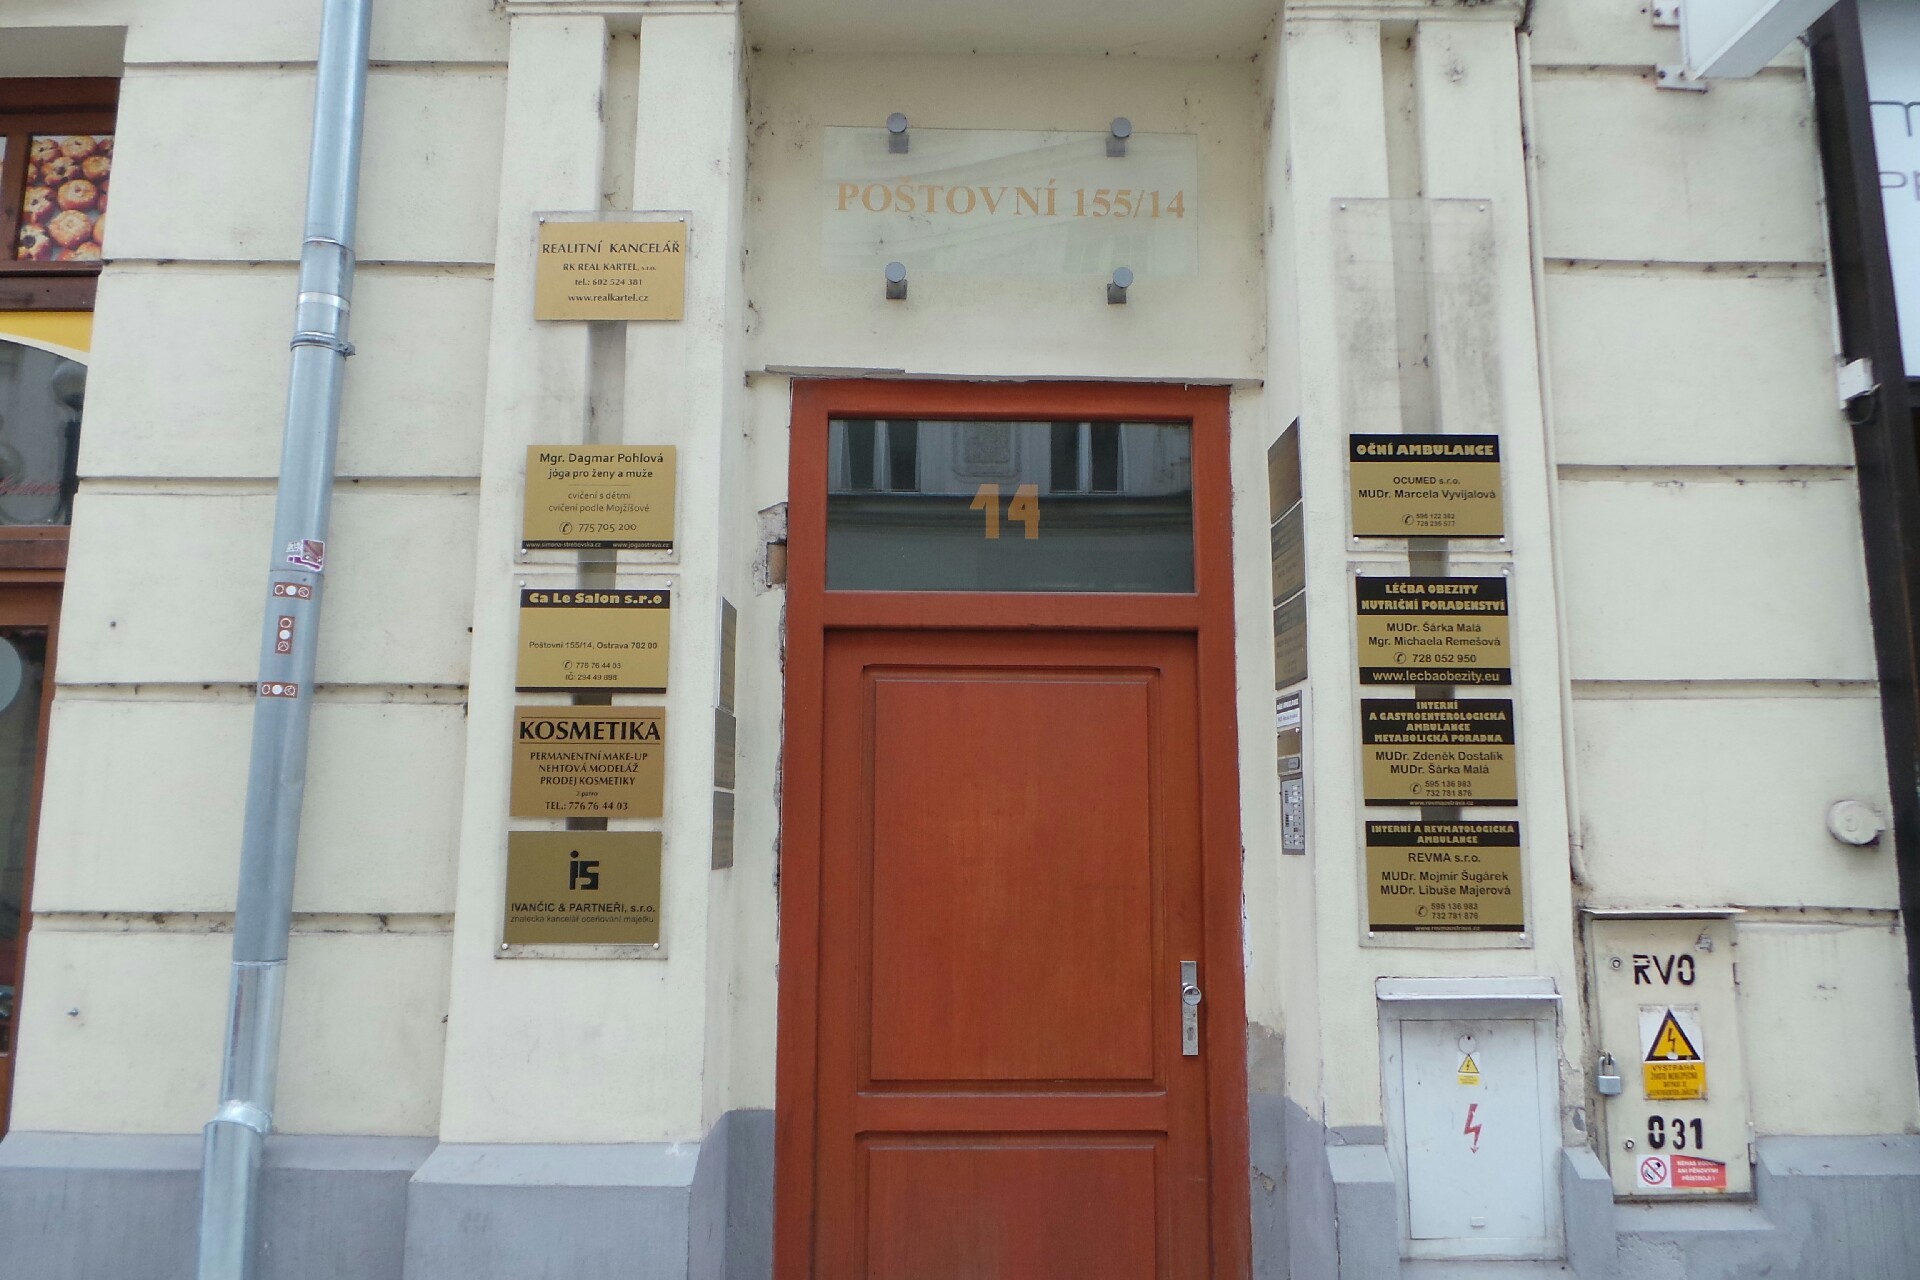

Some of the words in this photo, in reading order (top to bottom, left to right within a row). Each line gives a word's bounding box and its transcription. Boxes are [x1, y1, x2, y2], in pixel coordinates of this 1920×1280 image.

[835, 177, 1057, 216] POŠTOVNÍ
[1073, 187, 1186, 219] 155/14
[542, 240, 603, 254] REALITNÍ
[609, 240, 680, 253] KANCELÁŘ
[563, 263, 576, 271] RK
[578, 263, 600, 271] REAL
[603, 263, 640, 272] KARTEL,
[568, 293, 649, 302] www.realkartel.cz
[1356, 442, 1394, 456] OČNÍ
[1396, 444, 1494, 456] AMBULANCE
[539, 453, 565, 466] Mgr.
[568, 453, 614, 466] Dagmar
[617, 452, 664, 464] Pohlová
[547, 468, 571, 480] jóga
[572, 470, 589, 480] pro
[591, 468, 615, 480] ženy
[617, 470, 624, 478] a
[626, 468, 653, 478] muže
[1393, 476, 1437, 485] OCUMED
[567, 491, 598, 500] cvičení
[605, 491, 631, 500] dětmi
[1358, 489, 1392, 499] MUDr.
[1394, 489, 1439, 499] Marcela
[548, 503, 578, 512] cvičení
[579, 503, 604, 514] podle
[606, 503, 650, 514] Mojžíšové
[969, 483, 1041, 540] 14
[578, 523, 595, 533] 775
[597, 523, 615, 533] 705
[618, 523, 637, 531] 200
[1385, 583, 1426, 594] LÉČBA
[1427, 584, 1479, 594] OBEZITY
[529, 592, 549, 604] Ca
[552, 592, 571, 604] Le
[574, 593, 620, 604] Salon
[624, 594, 662, 605] s.r.o
[1361, 598, 1419, 610] NUTRIČNÍ
[1421, 599, 1506, 611] PORADENSTVÍ
[1386, 622, 1420, 632] MUDr.
[1422, 620, 1454, 632] Šárka
[1456, 622, 1482, 632] Malá
[529, 641, 564, 649] Poštovní
[565, 641, 595, 650] 155/14,
[596, 641, 629, 650] Ostrava
[630, 642, 646, 650] 702
[647, 642, 658, 650] 00
[1368, 636, 1391, 648] Mgr.
[1394, 636, 1443, 646] Michaela
[1445, 636, 1501, 646] Remešová
[1412, 654, 1431, 663] 728
[1434, 654, 1454, 663] 052
[1457, 654, 1477, 663] 950
[1372, 670, 1500, 683] www.lecbaobezity.eu
[1416, 700, 1458, 710] INTERNÍ
[1369, 712, 1378, 721] A
[1379, 711, 1507, 721] GASTROENTEROLOGICKÁ
[519, 721, 661, 741] KOSMETIKA
[1406, 723, 1471, 732] AMBULANCE
[1374, 733, 1449, 743] METABOLICKÁ
[1451, 734, 1503, 743] PORADNA
[530, 751, 602, 761] PERMANENTNÍ
[602, 752, 648, 761] MAKE-UP
[1375, 751, 1410, 761] MUDr.
[1412, 751, 1455, 761] Zdeněk
[538, 763, 587, 773] NEHTOVÁ
[589, 762, 639, 773] MODELÁŽ
[1390, 765, 1425, 774] MUDr.
[1428, 763, 1461, 775] Šárka
[1463, 765, 1490, 775] Malá
[540, 776, 577, 786] PRODEJ
[579, 776, 636, 786] KOSMETIKY
[1424, 780, 1440, 788] 595
[1457, 780, 1472, 788] 983
[1425, 789, 1440, 797] 732
[568, 801, 586, 811] 776
[587, 801, 599, 811] 76
[602, 801, 614, 811] 44
[616, 801, 628, 811] 03
[1371, 824, 1411, 833] INTERNÍ
[1414, 825, 1422, 833] A
[1423, 824, 1515, 833] REVMATOLOGICKÁ
[1416, 835, 1479, 844] AMBULANCE
[1408, 853, 1451, 863] REVMA
[1454, 854, 1481, 863] s.r.o.
[1381, 871, 1416, 881] MUDr.
[1419, 871, 1458, 883] Mojmír
[1461, 869, 1509, 883] Šugárek
[1380, 885, 1416, 895] MUDr.
[1418, 885, 1457, 895] Libuše
[1459, 885, 1511, 897] Majerová
[558, 903, 566, 912] &
[569, 901, 627, 914] PARTNEŘI,
[630, 905, 656, 913] s.r.o.
[1431, 902, 1446, 910] 595
[1463, 902, 1478, 910] 983
[623, 915, 654, 925] majetku
[1431, 912, 1446, 920] 732
[1632, 954, 1696, 986] RVO
[1647, 1115, 1703, 1150] 031
